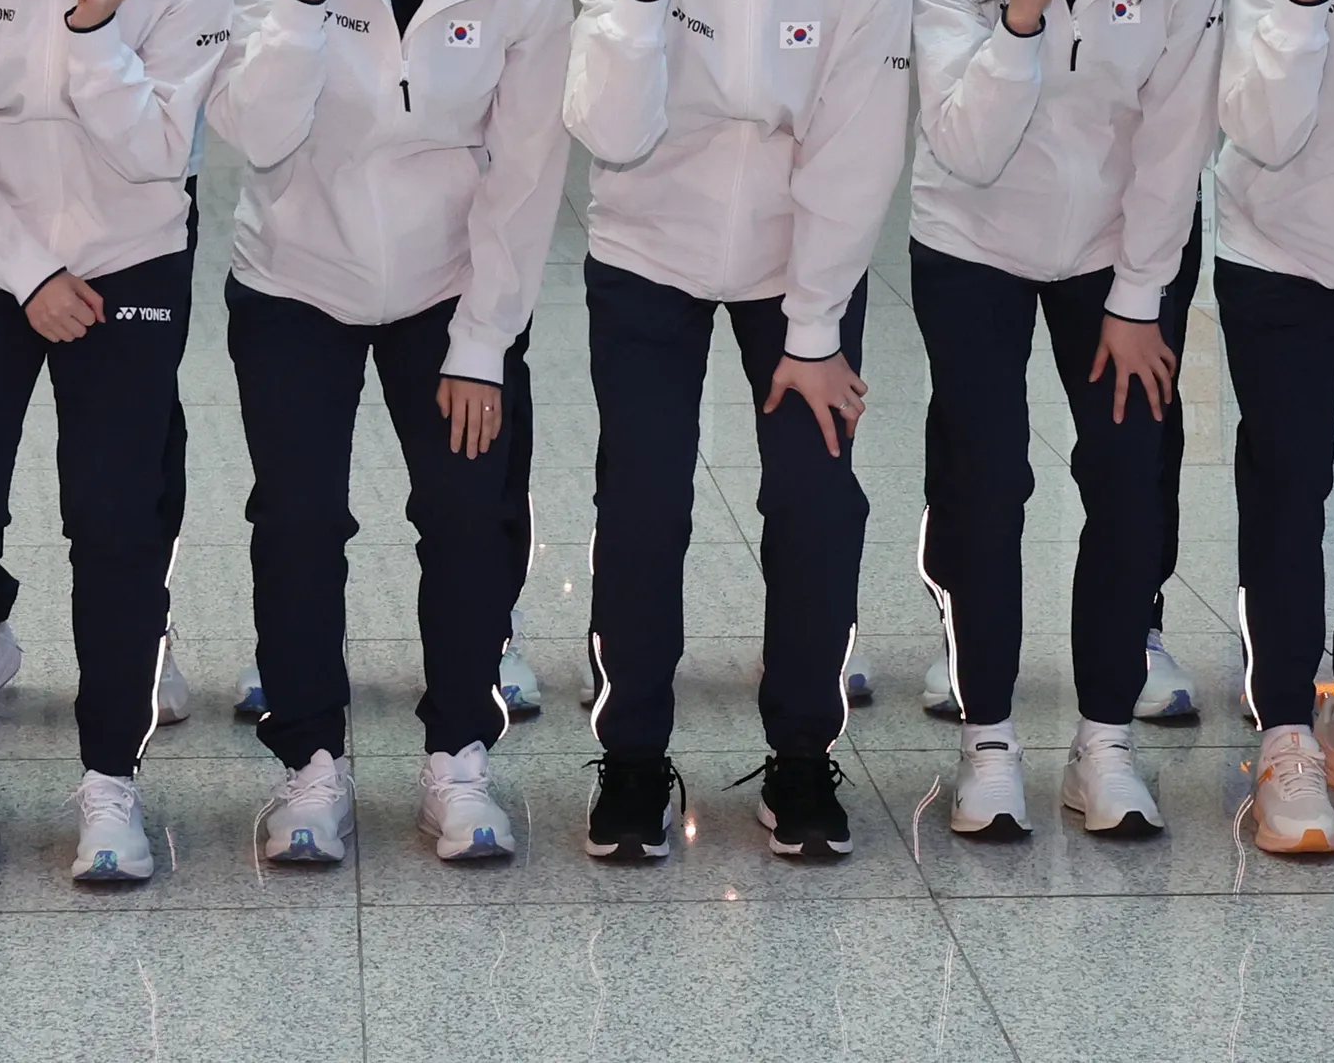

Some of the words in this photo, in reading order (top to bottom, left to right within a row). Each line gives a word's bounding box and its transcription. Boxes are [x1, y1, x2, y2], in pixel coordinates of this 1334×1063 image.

[335, 13, 370, 33] YONEX
[215, 29, 230, 44] YON
[892, 57, 910, 69] YON
[139, 307, 171, 321] YONEX
